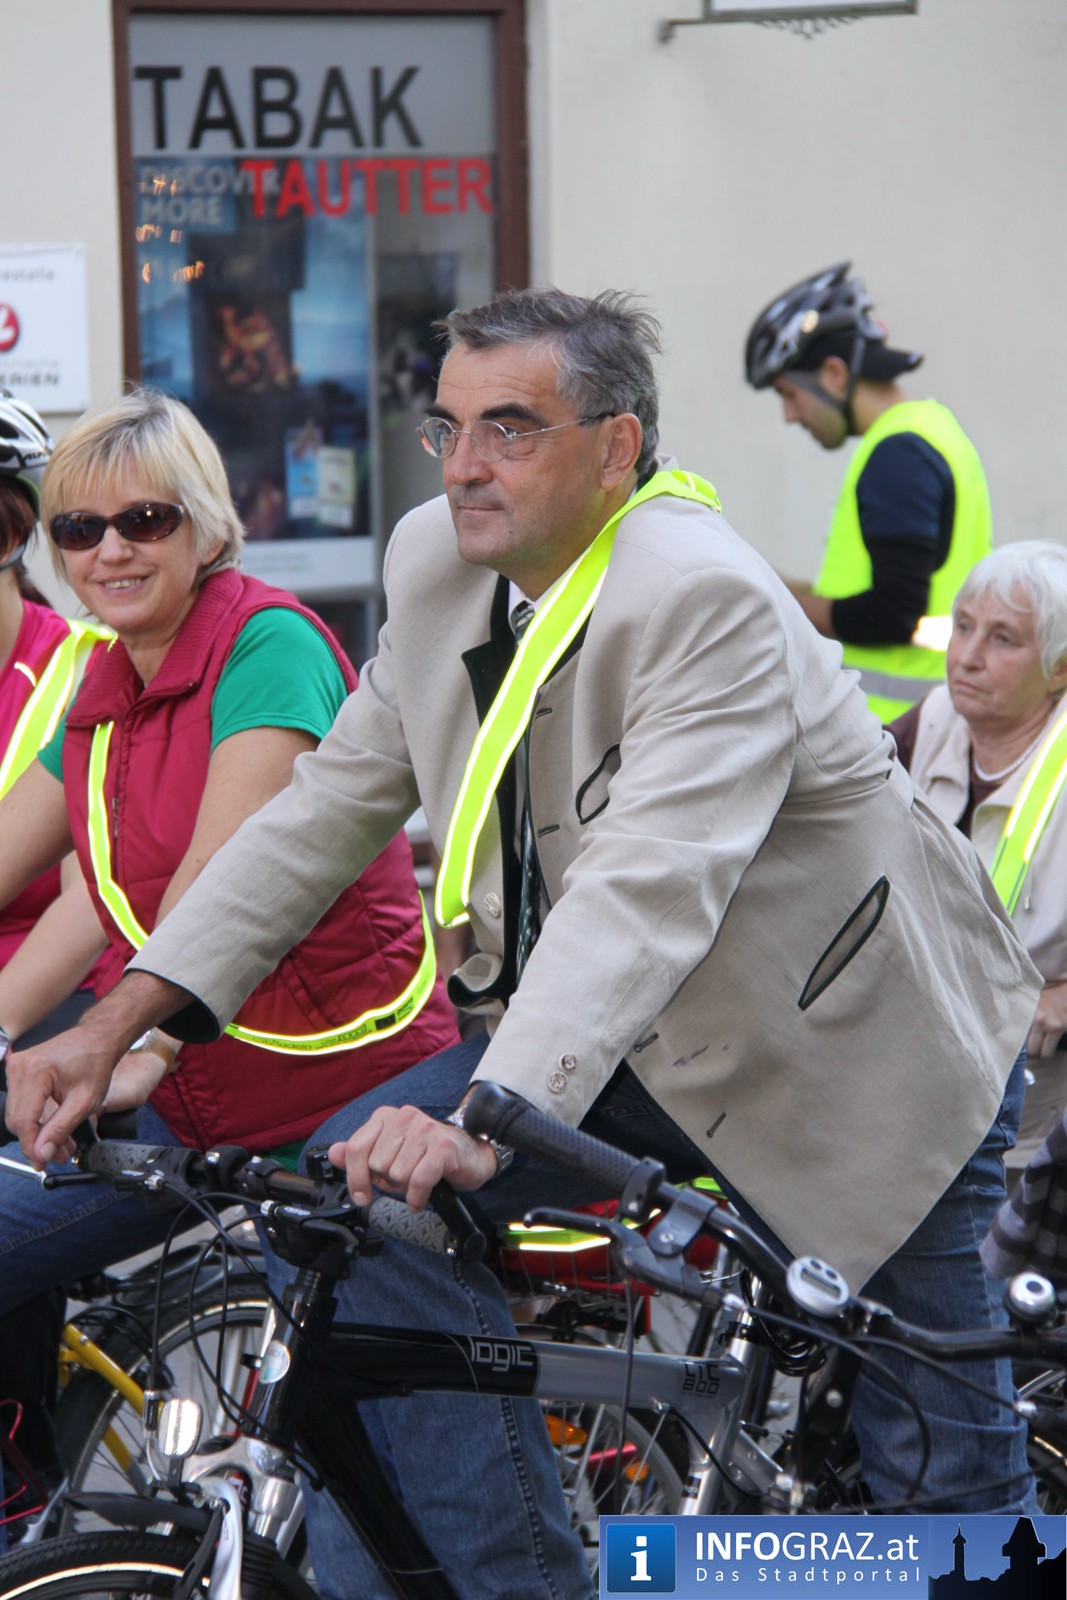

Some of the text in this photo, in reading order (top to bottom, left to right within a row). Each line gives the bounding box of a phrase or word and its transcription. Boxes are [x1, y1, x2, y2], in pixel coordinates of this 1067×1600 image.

[134, 65, 423, 151] TABAK
[140, 196, 223, 227] MORE
[240, 157, 495, 219] TAUTTER
[467, 1336, 534, 1373] logic
